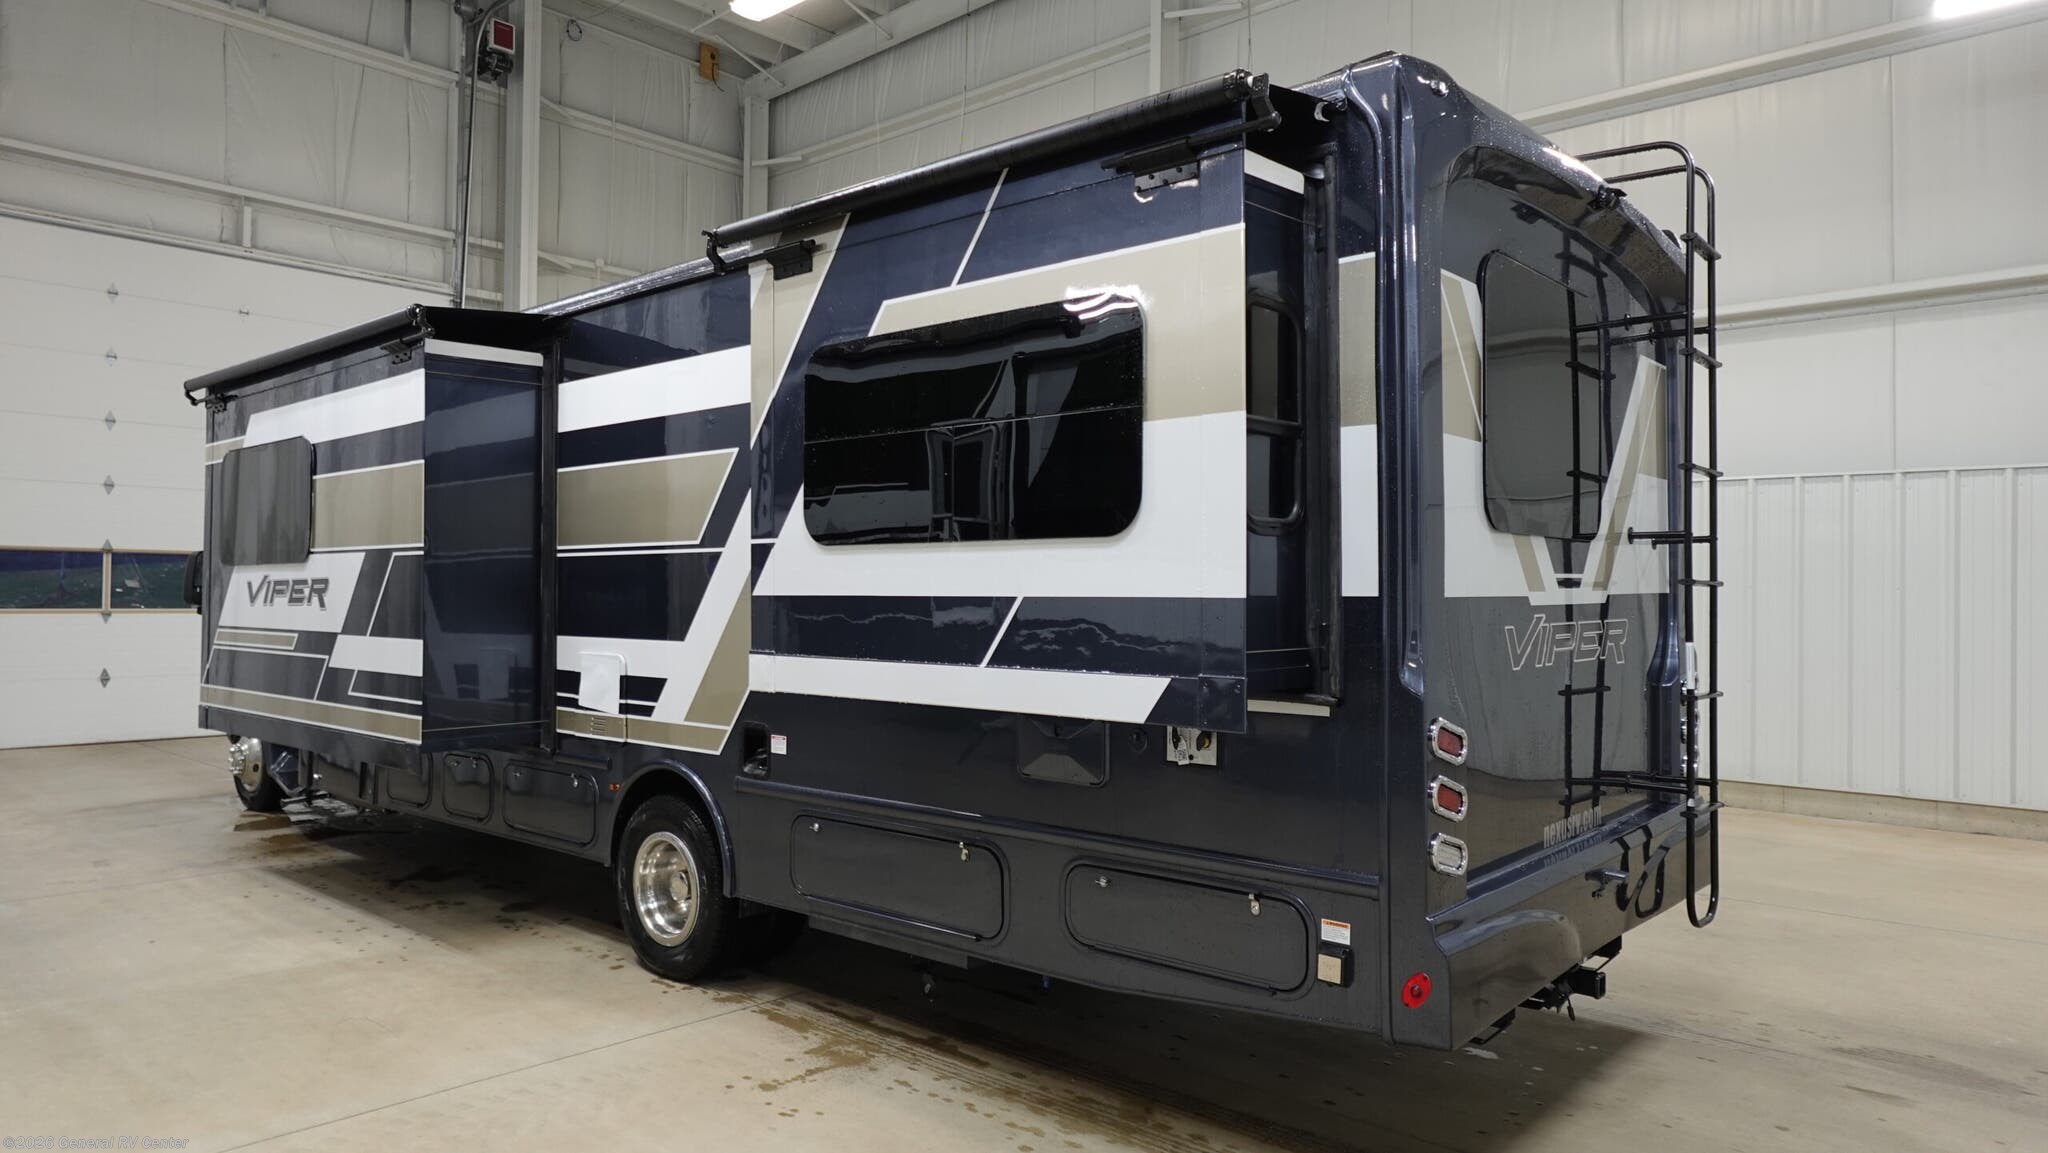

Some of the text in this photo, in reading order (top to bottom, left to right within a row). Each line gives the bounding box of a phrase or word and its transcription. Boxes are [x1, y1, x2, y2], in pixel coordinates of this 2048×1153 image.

[248, 575, 329, 611] VIPER
[1504, 614, 1628, 671] VIPER
[1543, 806, 1602, 848] nexusrv.com
